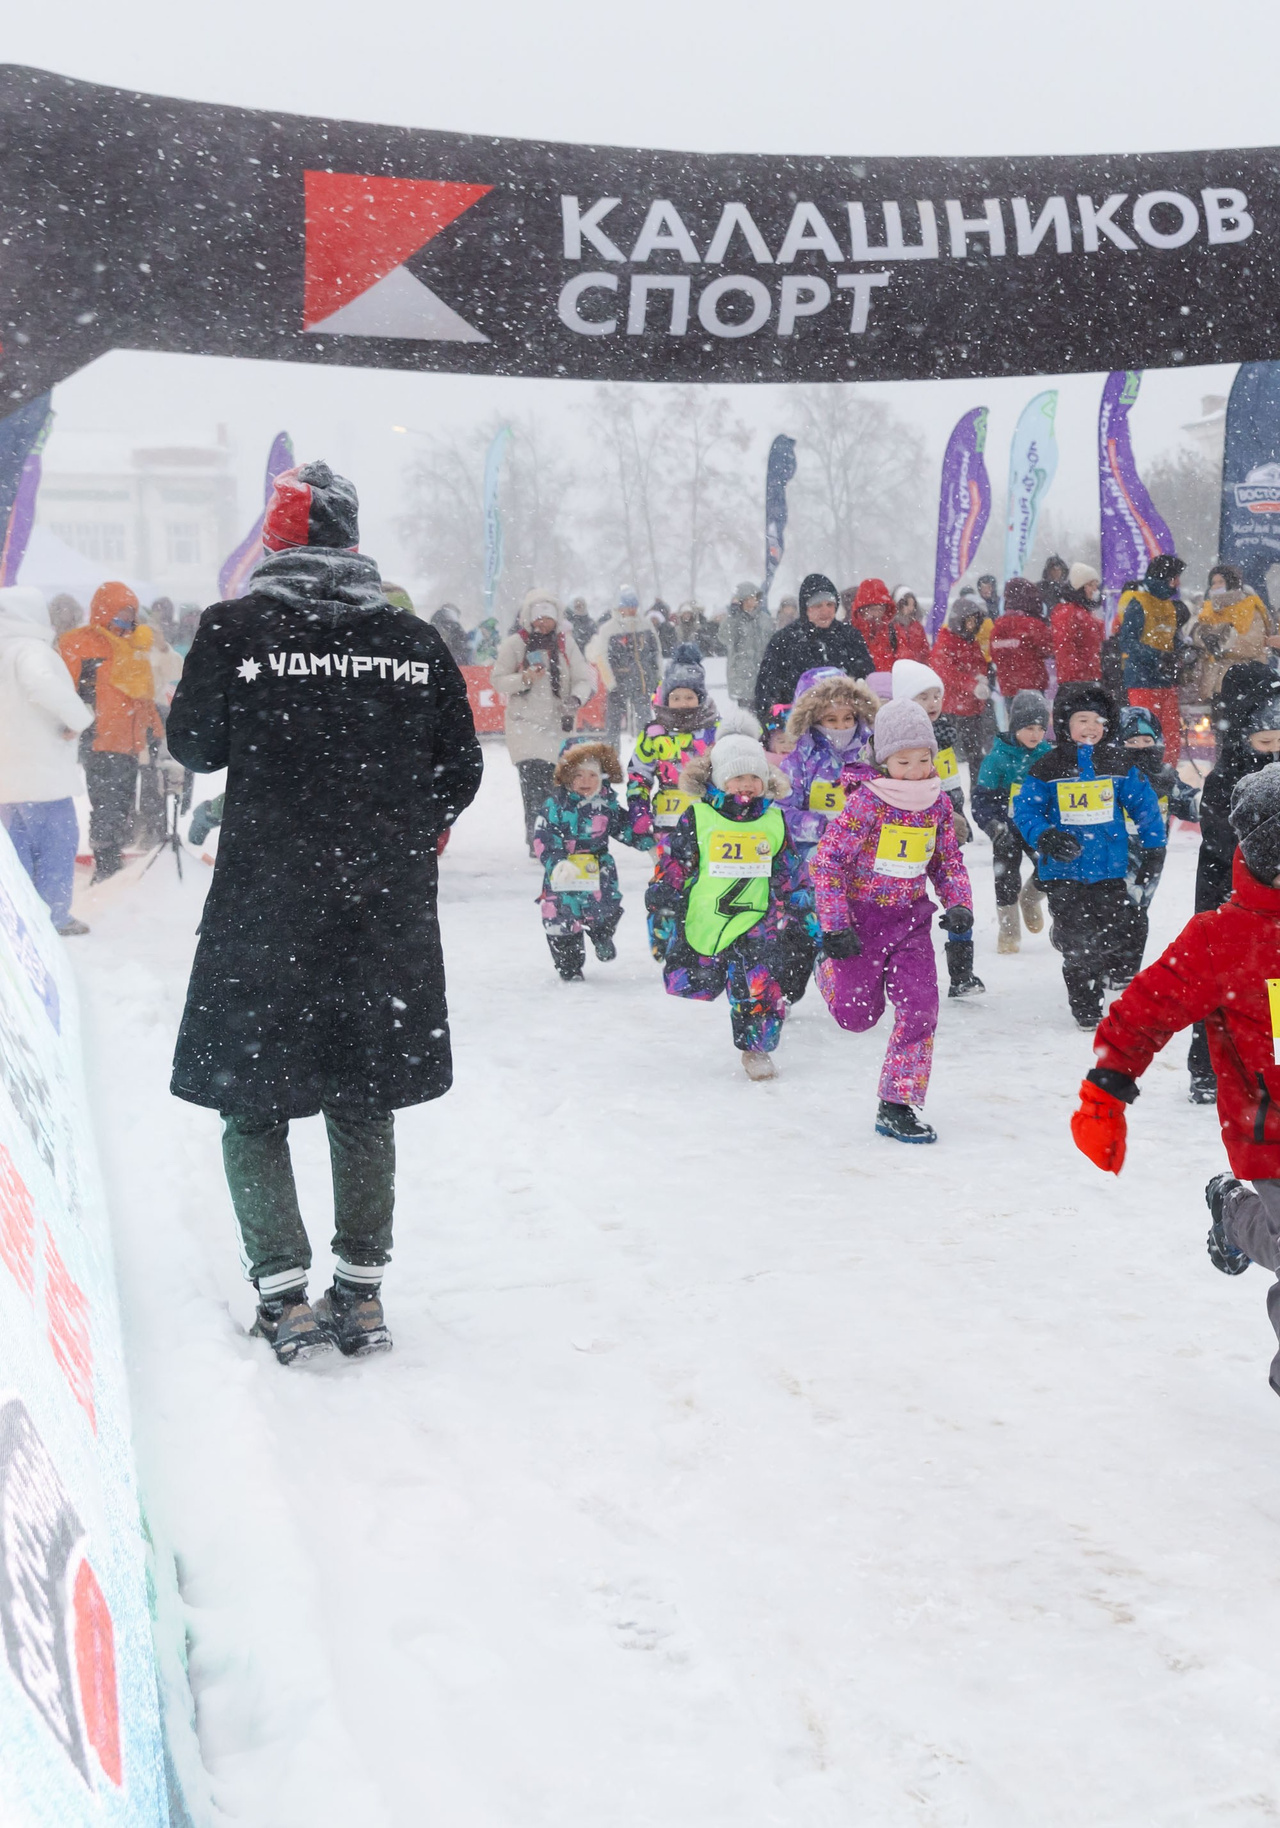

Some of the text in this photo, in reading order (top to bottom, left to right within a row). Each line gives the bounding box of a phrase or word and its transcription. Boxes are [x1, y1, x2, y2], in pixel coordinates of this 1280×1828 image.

[560, 188, 1255, 263] КАЛАШНИКОВ
[558, 272, 891, 337] СПОРТ
[268, 652, 430, 685] УДМУРТИЯ
[664, 799, 681, 812] 17
[824, 794, 836, 808] 5
[1068, 793, 1089, 808] 14
[721, 843, 744, 860] 21
[897, 840, 908, 858] 1
